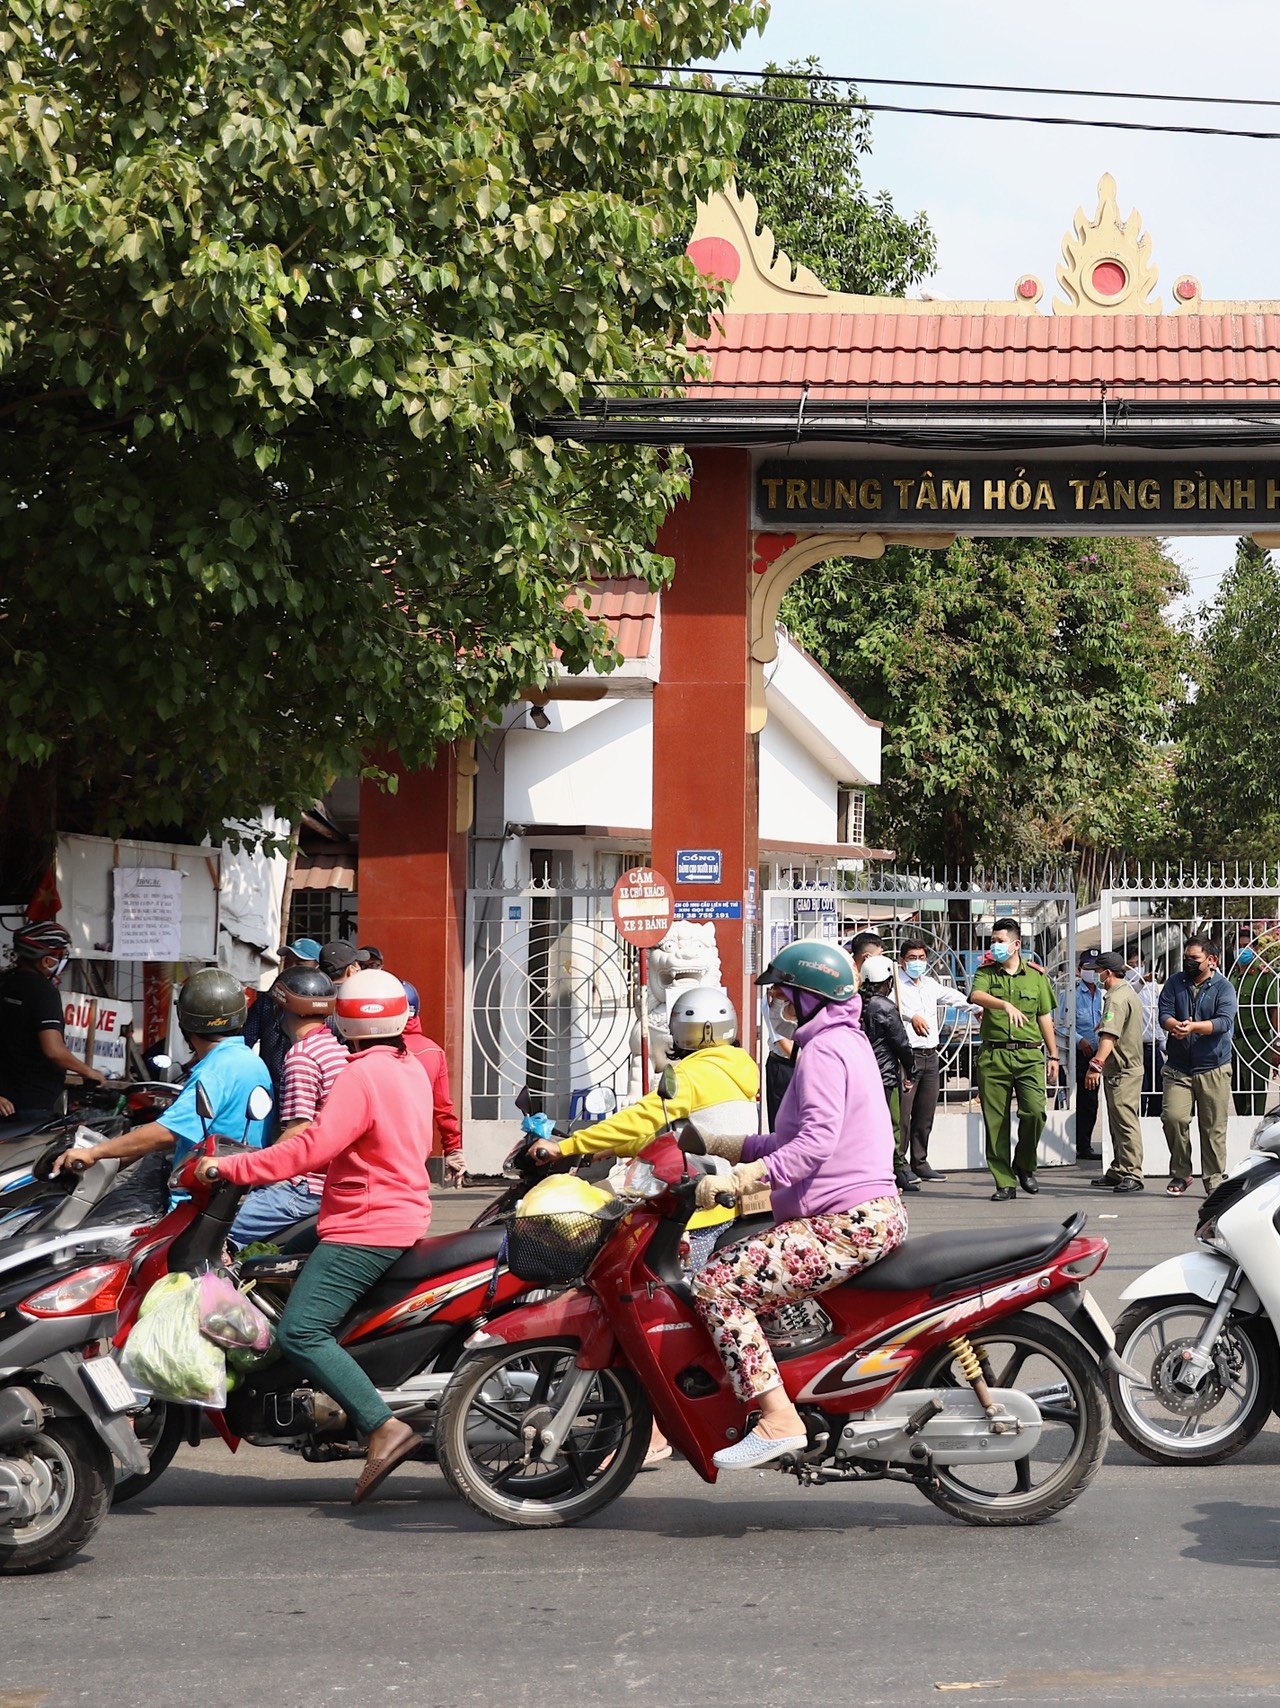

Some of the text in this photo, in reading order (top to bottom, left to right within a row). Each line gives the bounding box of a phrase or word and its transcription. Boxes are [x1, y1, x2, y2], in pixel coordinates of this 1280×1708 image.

[761, 477, 881, 511] TRUNG
[893, 470, 970, 510] TÂM
[983, 466, 1055, 510] HỎA
[1068, 470, 1161, 510] TÁNG
[1173, 470, 1256, 510] BÌNH
[619, 887, 630, 899] XE
[623, 915, 668, 931] XE 2 BÁNH
[95, 1009, 117, 1032] XE
